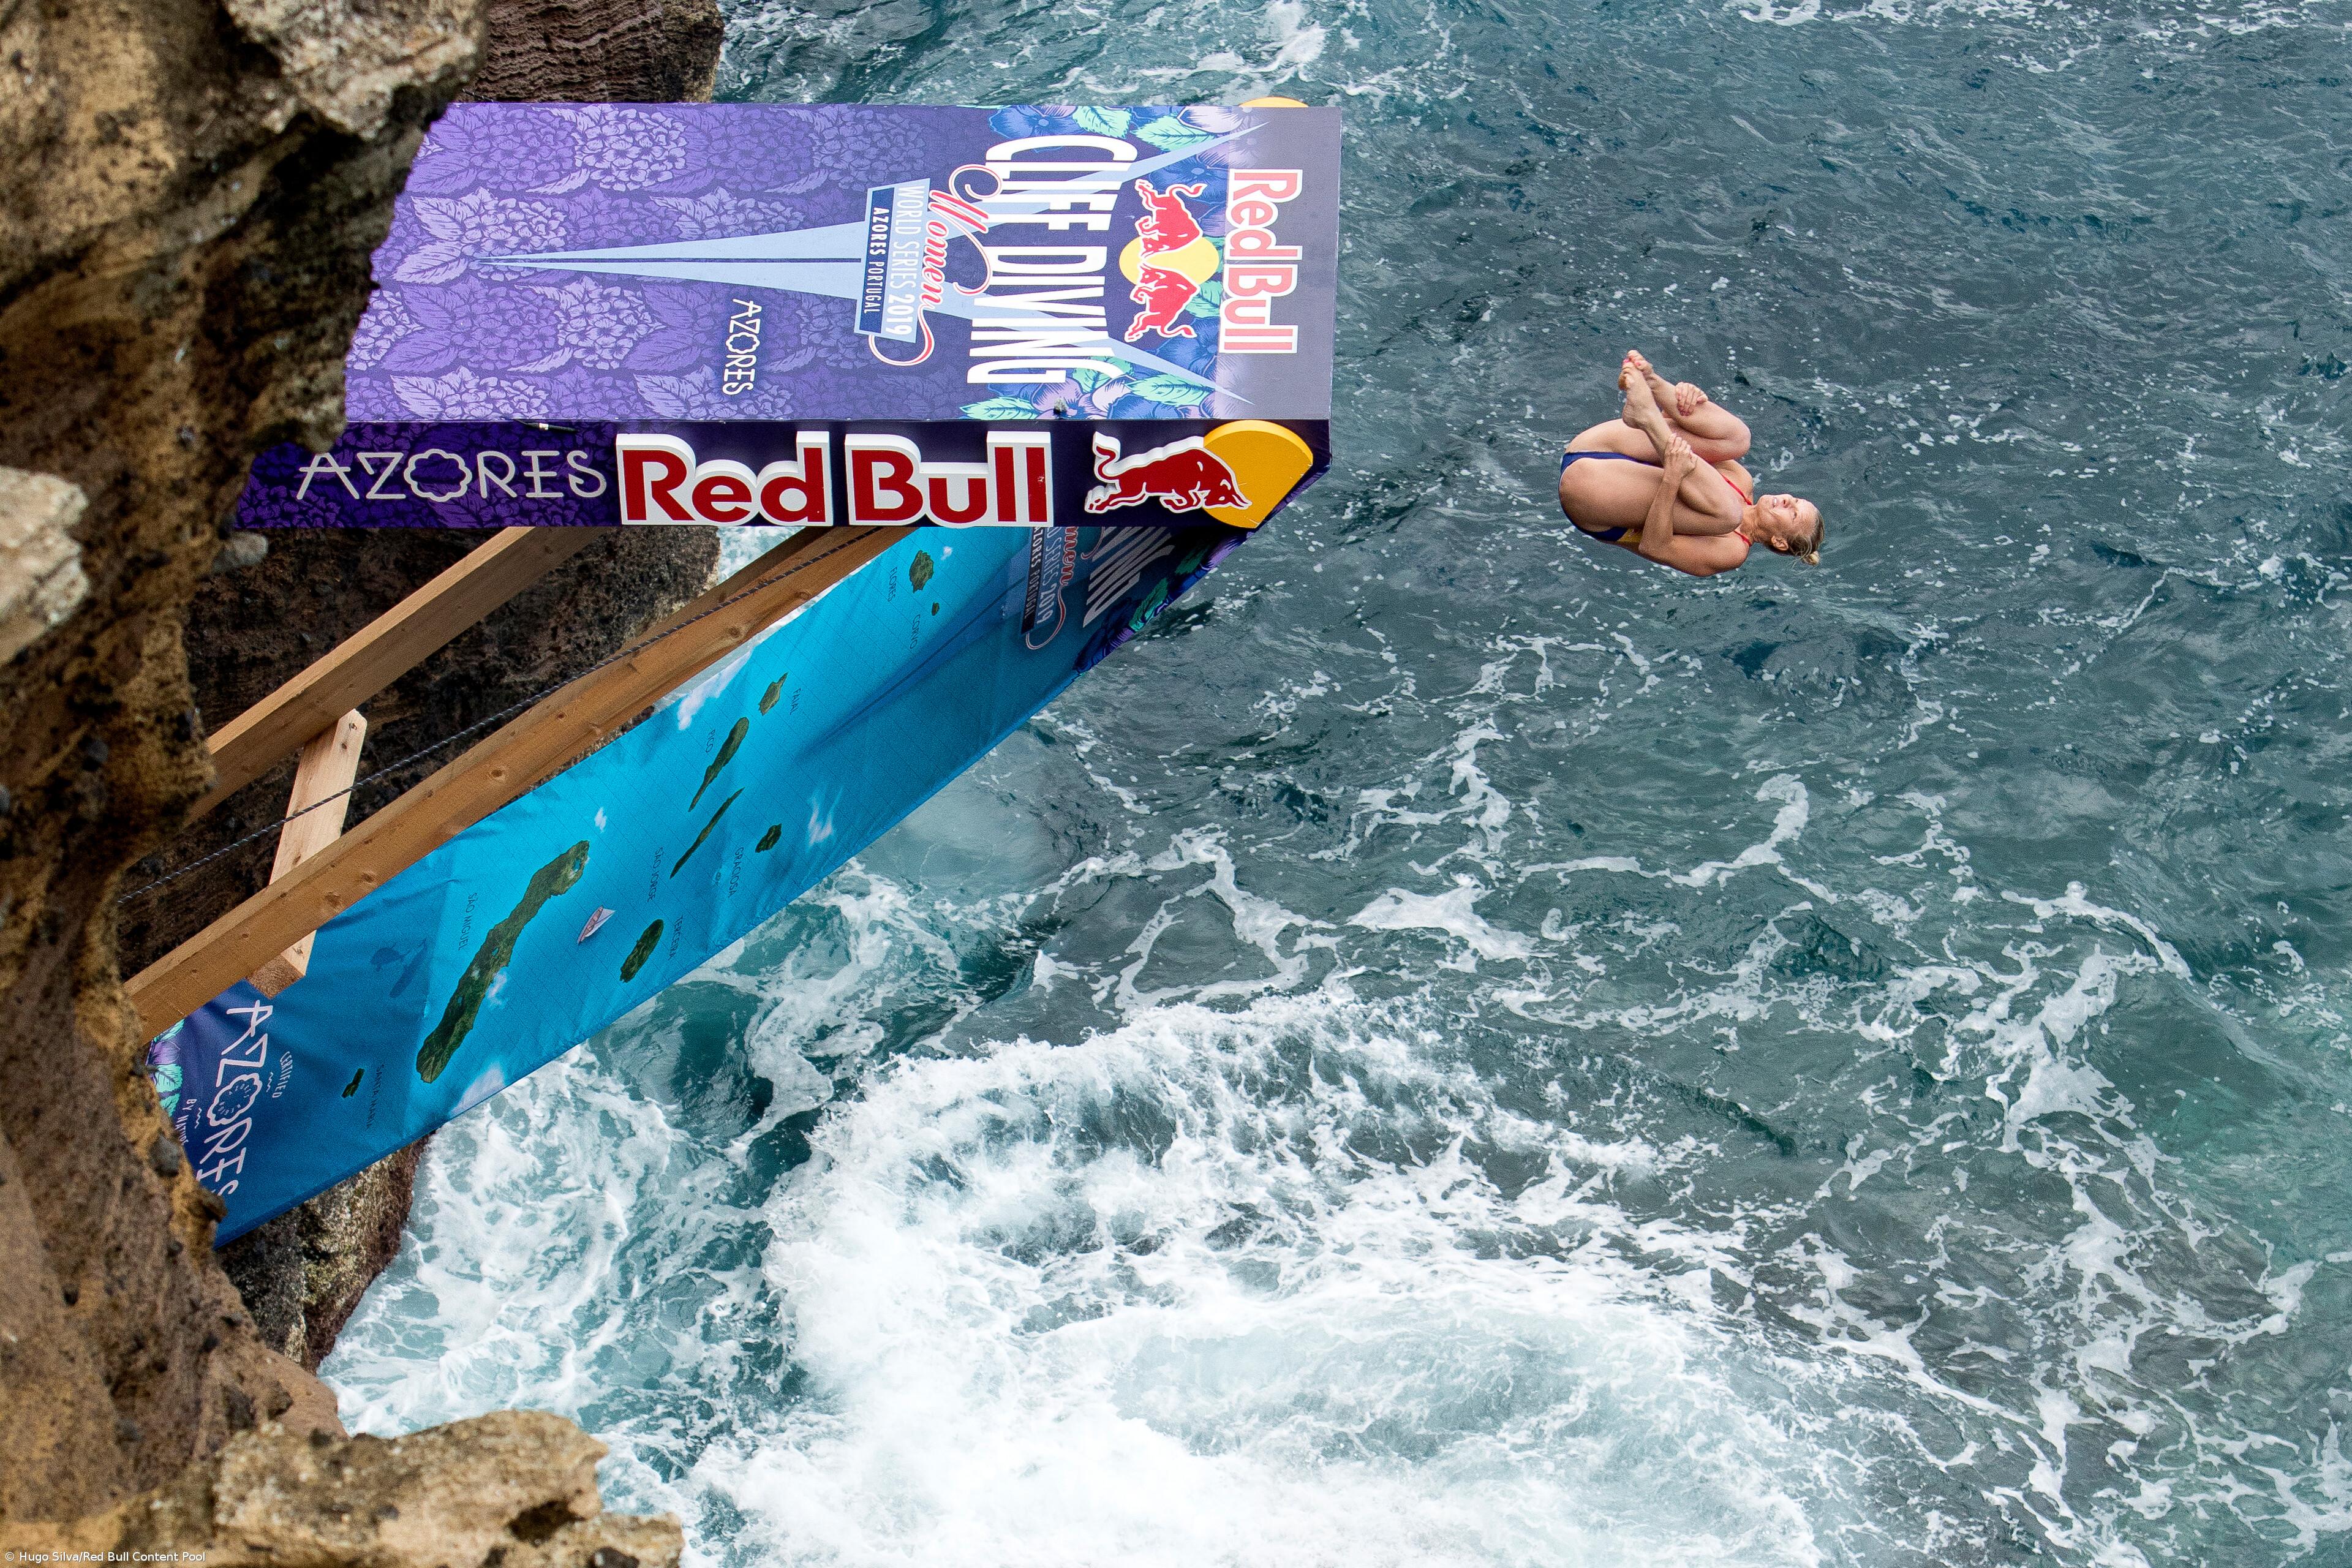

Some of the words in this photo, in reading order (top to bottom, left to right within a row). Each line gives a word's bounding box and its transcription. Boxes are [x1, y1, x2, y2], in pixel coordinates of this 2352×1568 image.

[985, 135, 1137, 230] CLIFF
[870, 206, 890, 255] AZORES
[894, 186, 924, 235] WORLD
[1226, 168, 1303, 262] Red
[889, 241, 920, 288] SERIES
[913, 164, 1002, 318] Women
[864, 262, 885, 314] PORTUGAL
[1218, 260, 1300, 354] Bull
[885, 294, 916, 336] 2019
[967, 245, 1128, 384] DIVING
[722, 298, 762, 396] AZORES
[296, 449, 608, 502] AZORES
[617, 431, 833, 527] Red
[845, 431, 1054, 527] Bull
[886, 566, 899, 602] FLORES
[1042, 537, 1062, 586] SERIES
[1083, 526, 1175, 628] VING
[1024, 568, 1040, 619] PORTUGAL
[1036, 583, 1058, 624] 2019
[910, 614, 922, 649] CORVO
[789, 688, 802, 715] FAIAL
[704, 729, 716, 753] PICO
[647, 871, 660, 903] JORGE
[727, 846, 744, 899] GRACIOSA
[458, 914, 473, 951] MIGUEL
[668, 915, 684, 960] TERCEIRA
[271, 1051, 293, 1098] CERTIFIED
[372, 1064, 385, 1097] SANTA
[183, 1098, 197, 1110] BY
[365, 1099, 379, 1131] MARIA
